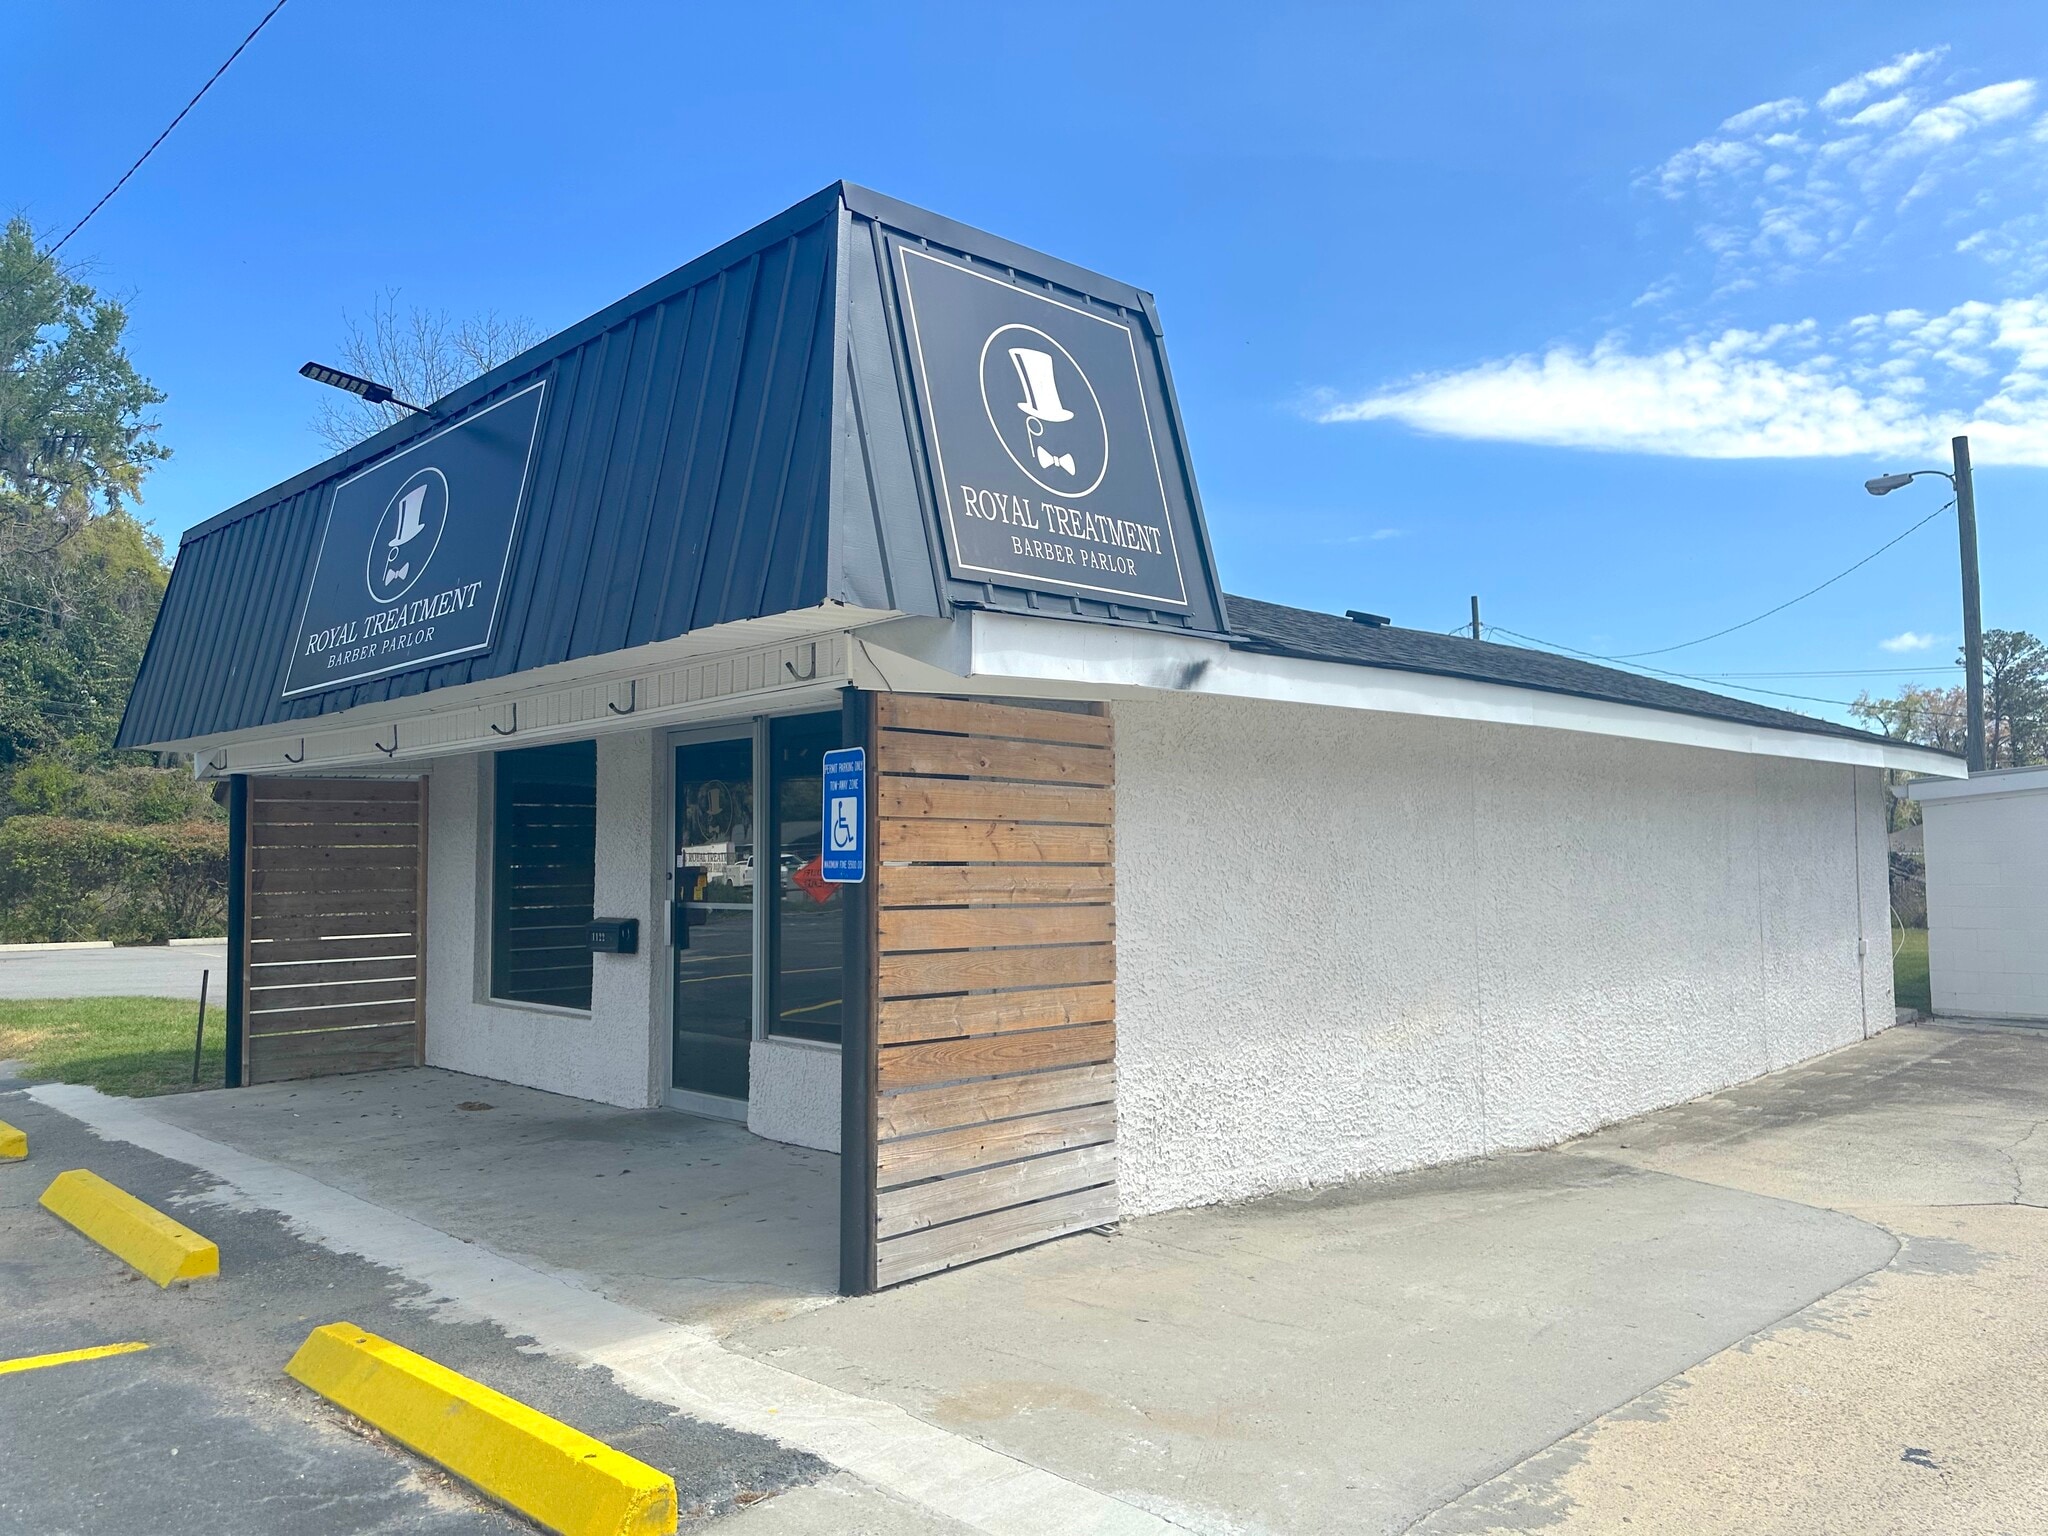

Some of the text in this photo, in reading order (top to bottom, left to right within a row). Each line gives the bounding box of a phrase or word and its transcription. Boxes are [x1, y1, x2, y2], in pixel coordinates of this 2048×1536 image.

[960, 485, 1162, 555] ROYAL TREATMENT
[1011, 536, 1137, 577] BARBER PARLOR
[305, 580, 482, 656] ROYAL TREATMENT
[327, 626, 435, 668] BARBER PARLOR
[824, 760, 864, 774] PERMIT PARKING ONLY
[830, 778, 859, 791] TOW-AWAY ZONE
[839, 860, 847, 869] FINE
